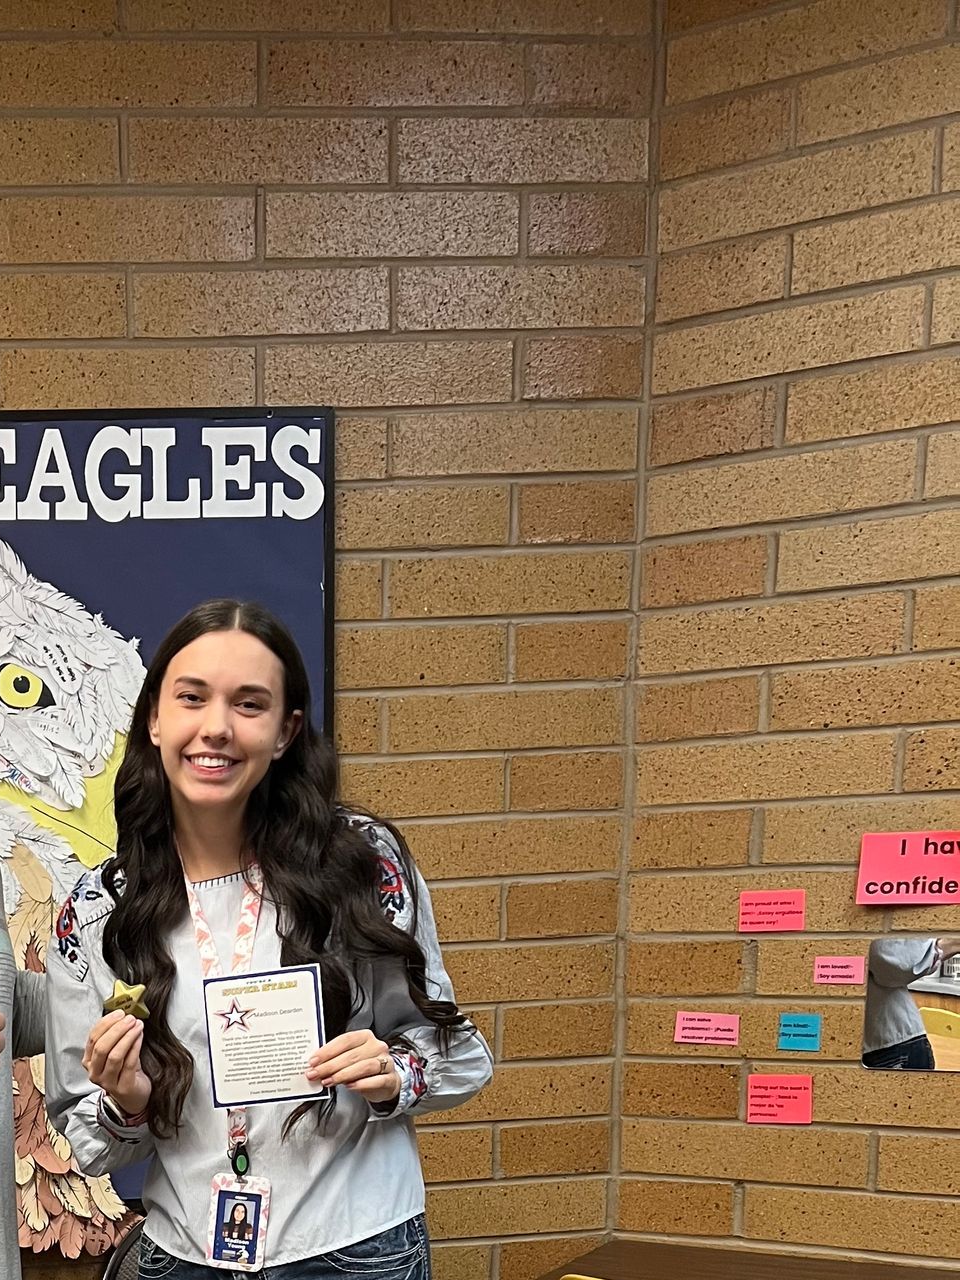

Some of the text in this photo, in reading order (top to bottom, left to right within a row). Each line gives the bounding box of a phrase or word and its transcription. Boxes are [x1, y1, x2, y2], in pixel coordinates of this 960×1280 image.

[900, 839, 907, 856] I
[865, 875, 959, 895] confide
[222, 985, 261, 997] SUPER
